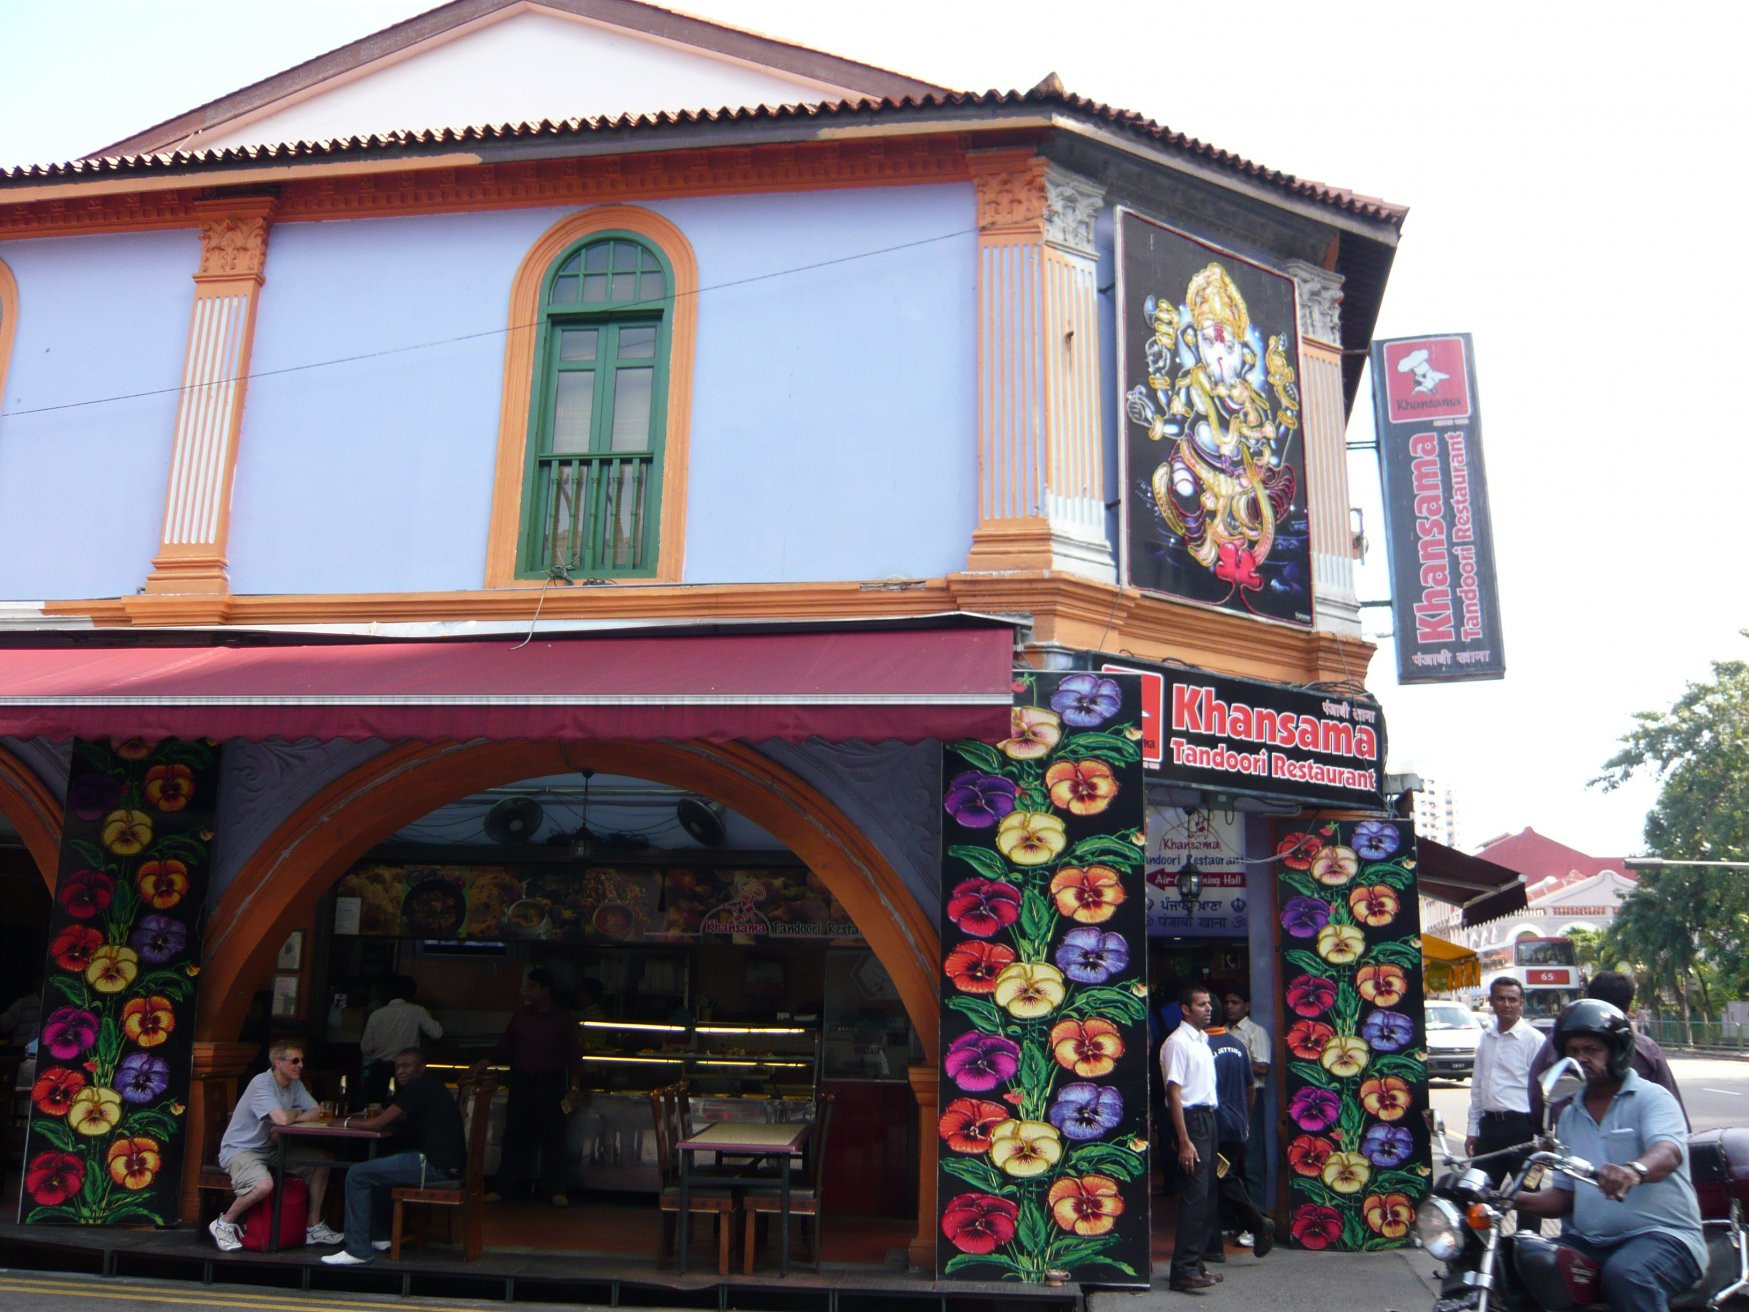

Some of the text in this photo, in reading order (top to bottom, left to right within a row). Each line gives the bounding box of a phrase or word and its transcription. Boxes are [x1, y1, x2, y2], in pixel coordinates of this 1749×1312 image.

[1444, 431, 1473, 542] Restaurant
[1409, 432, 1455, 643] Khansama
[1452, 545, 1482, 642] Tandoori
[1172, 683, 1376, 761] Khansama
[1170, 737, 1376, 791] Tandoori Restaurant
[1223, 874, 1241, 886] Hall
[1540, 972, 1554, 981] 65
